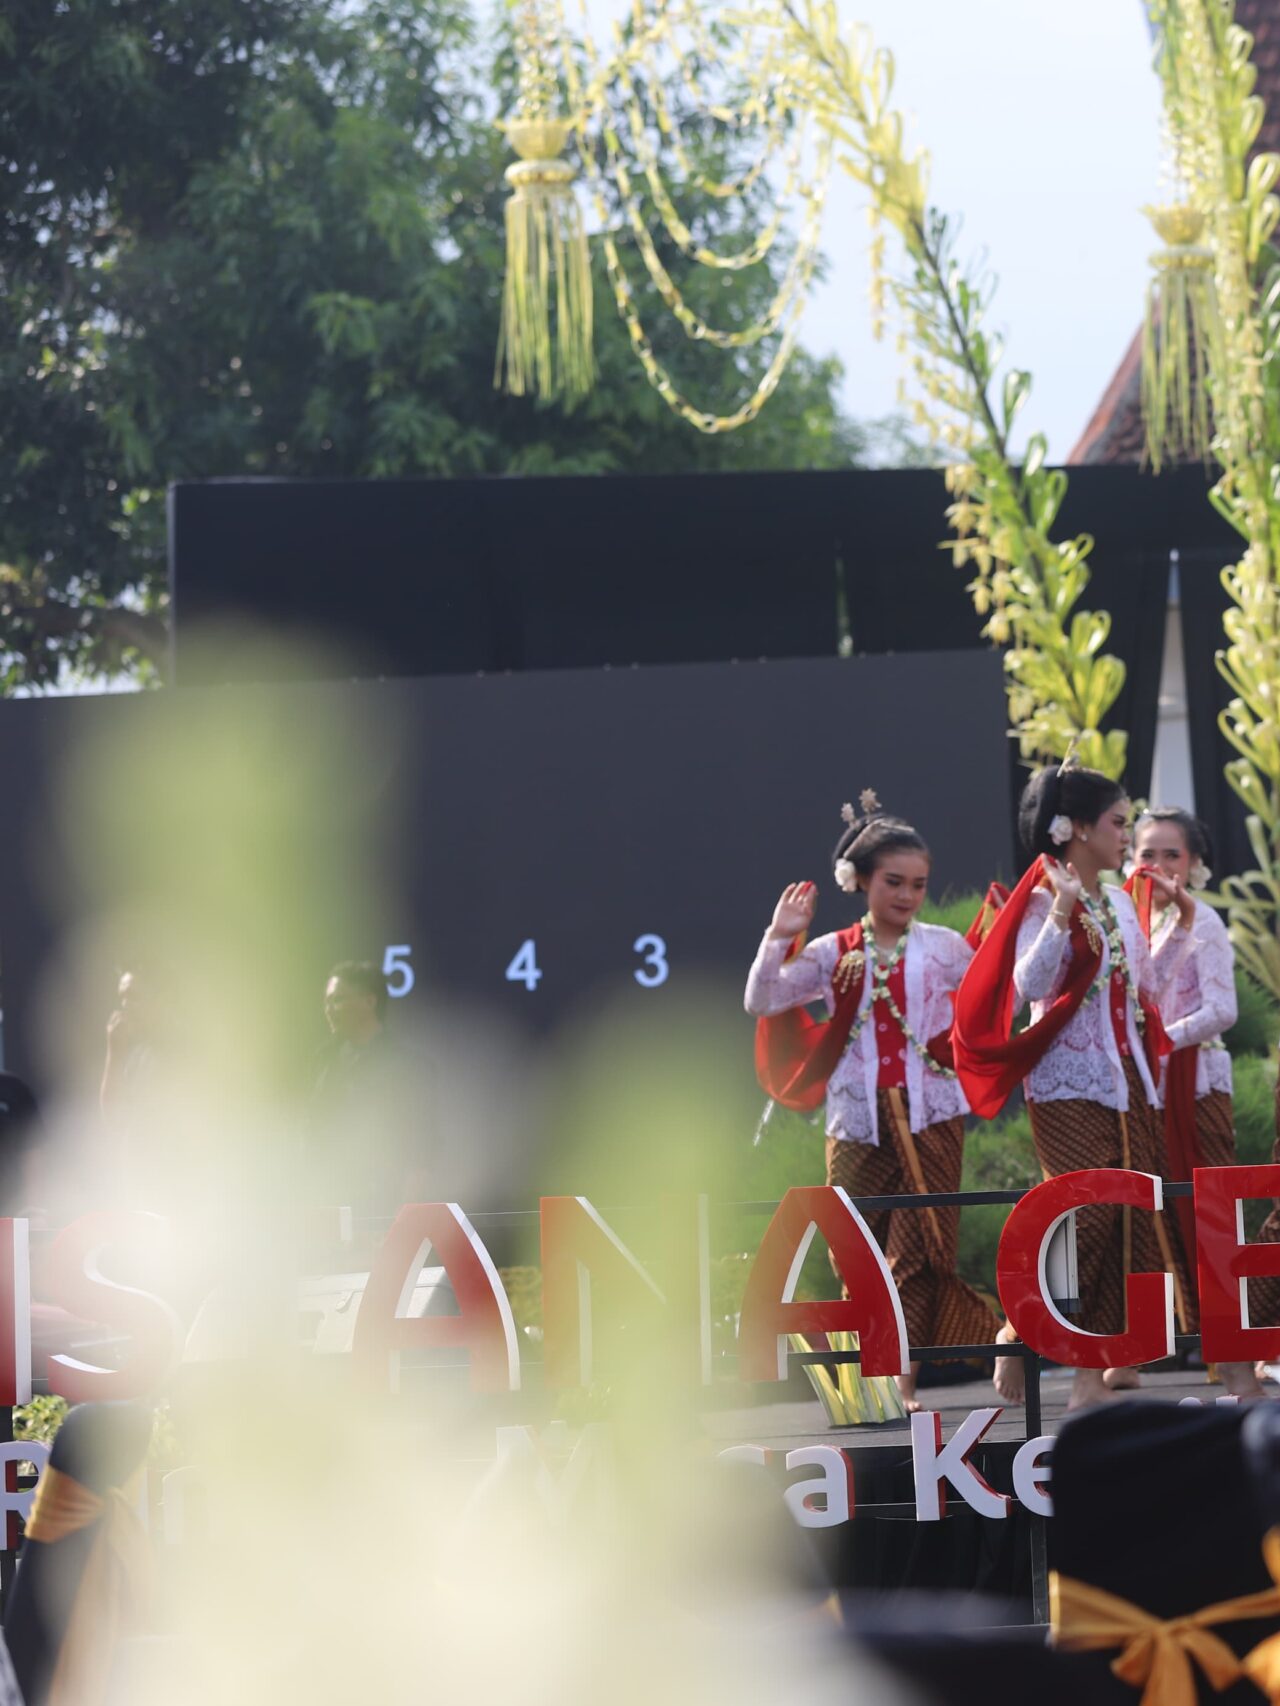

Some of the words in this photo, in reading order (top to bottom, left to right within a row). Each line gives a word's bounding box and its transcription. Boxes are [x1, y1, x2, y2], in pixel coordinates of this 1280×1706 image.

[382, 945, 415, 997] 5
[505, 939, 543, 991] 4
[633, 933, 669, 987] 3
[0, 1186, 911, 1400] ISANA
